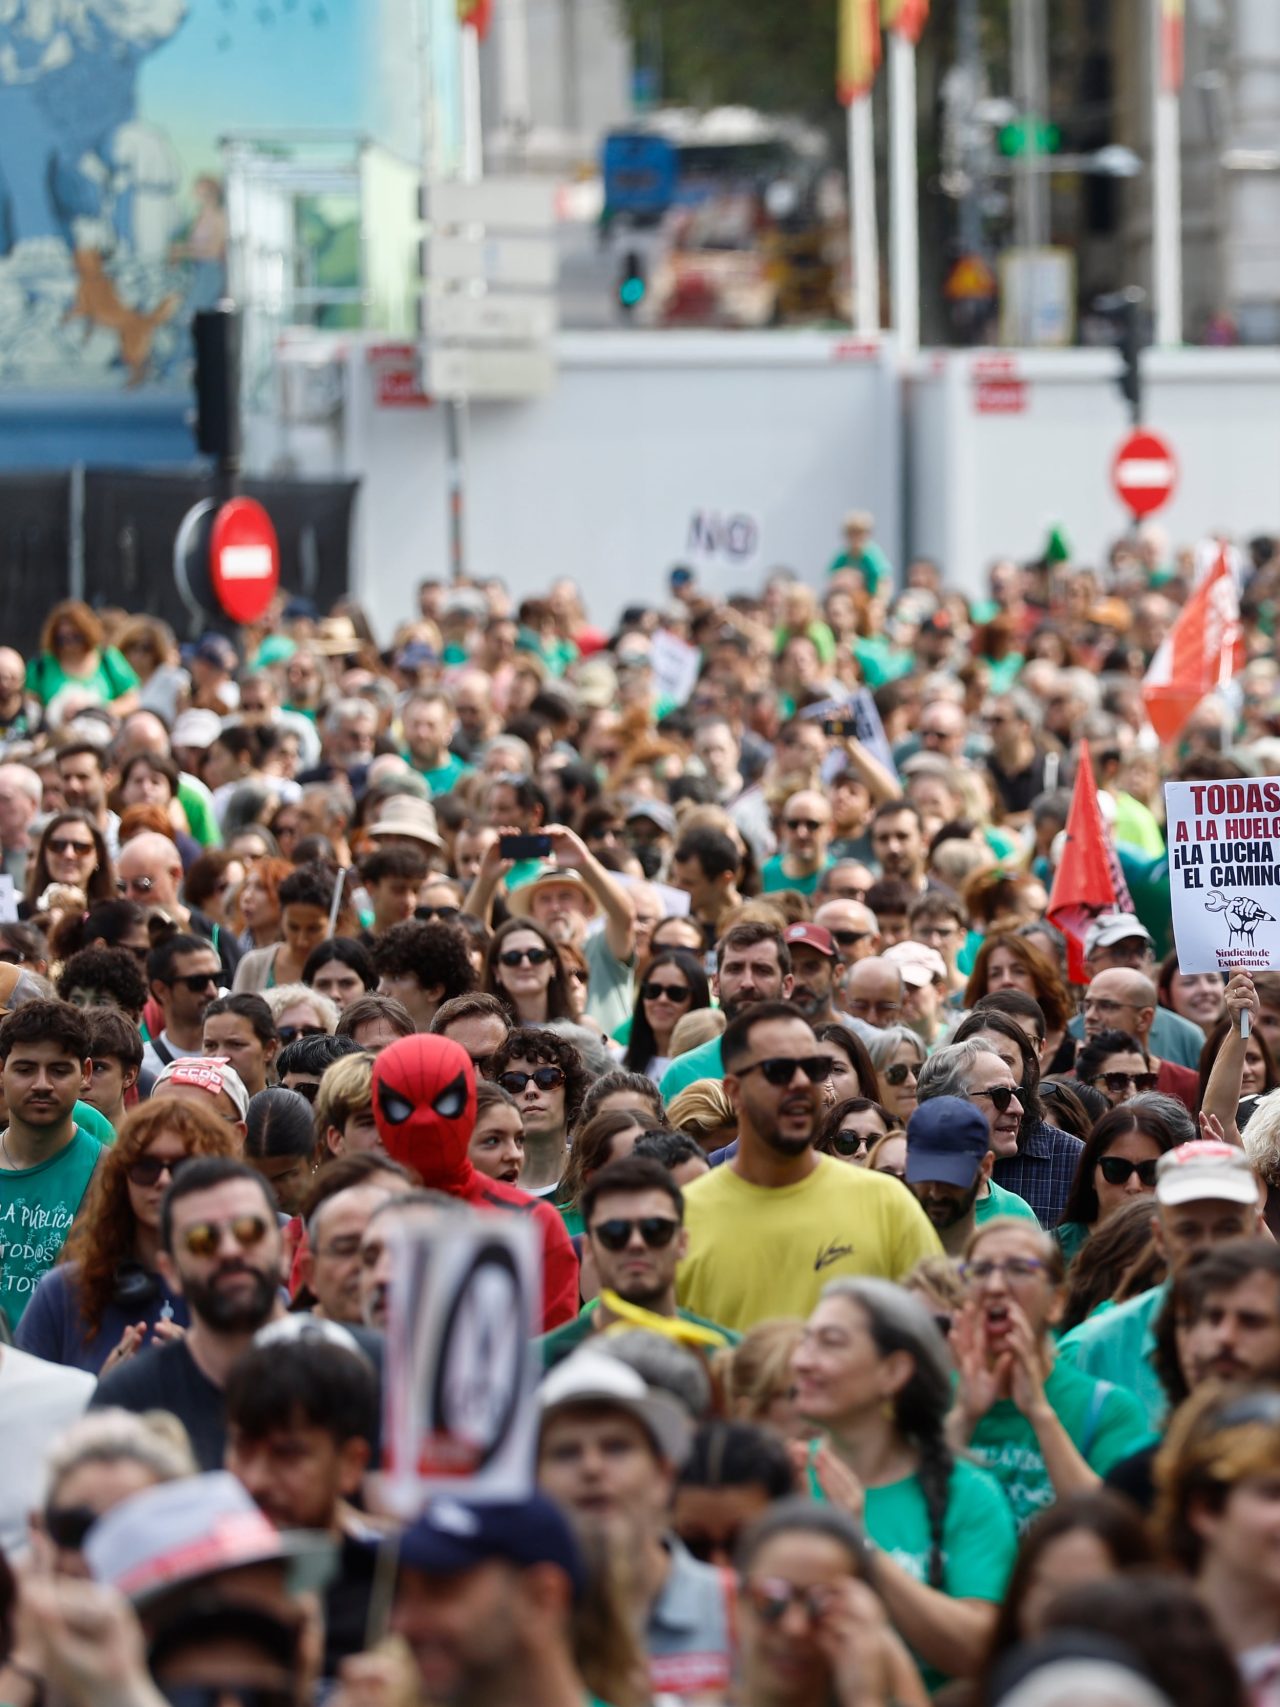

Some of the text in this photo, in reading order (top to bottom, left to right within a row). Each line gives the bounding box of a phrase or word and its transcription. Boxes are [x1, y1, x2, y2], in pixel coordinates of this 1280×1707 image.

[1190, 783, 1280, 815] TODAS
[1175, 821, 1189, 842] A
[1196, 820, 1218, 840] LA
[1174, 844, 1203, 869] ¡LA
[1211, 841, 1274, 863] LUCHA
[1184, 867, 1203, 888] EL
[1216, 949, 1270, 958] Sindicato de
[1218, 958, 1270, 967] Estudiantes
[21, 1203, 74, 1230] PÚBLICA
